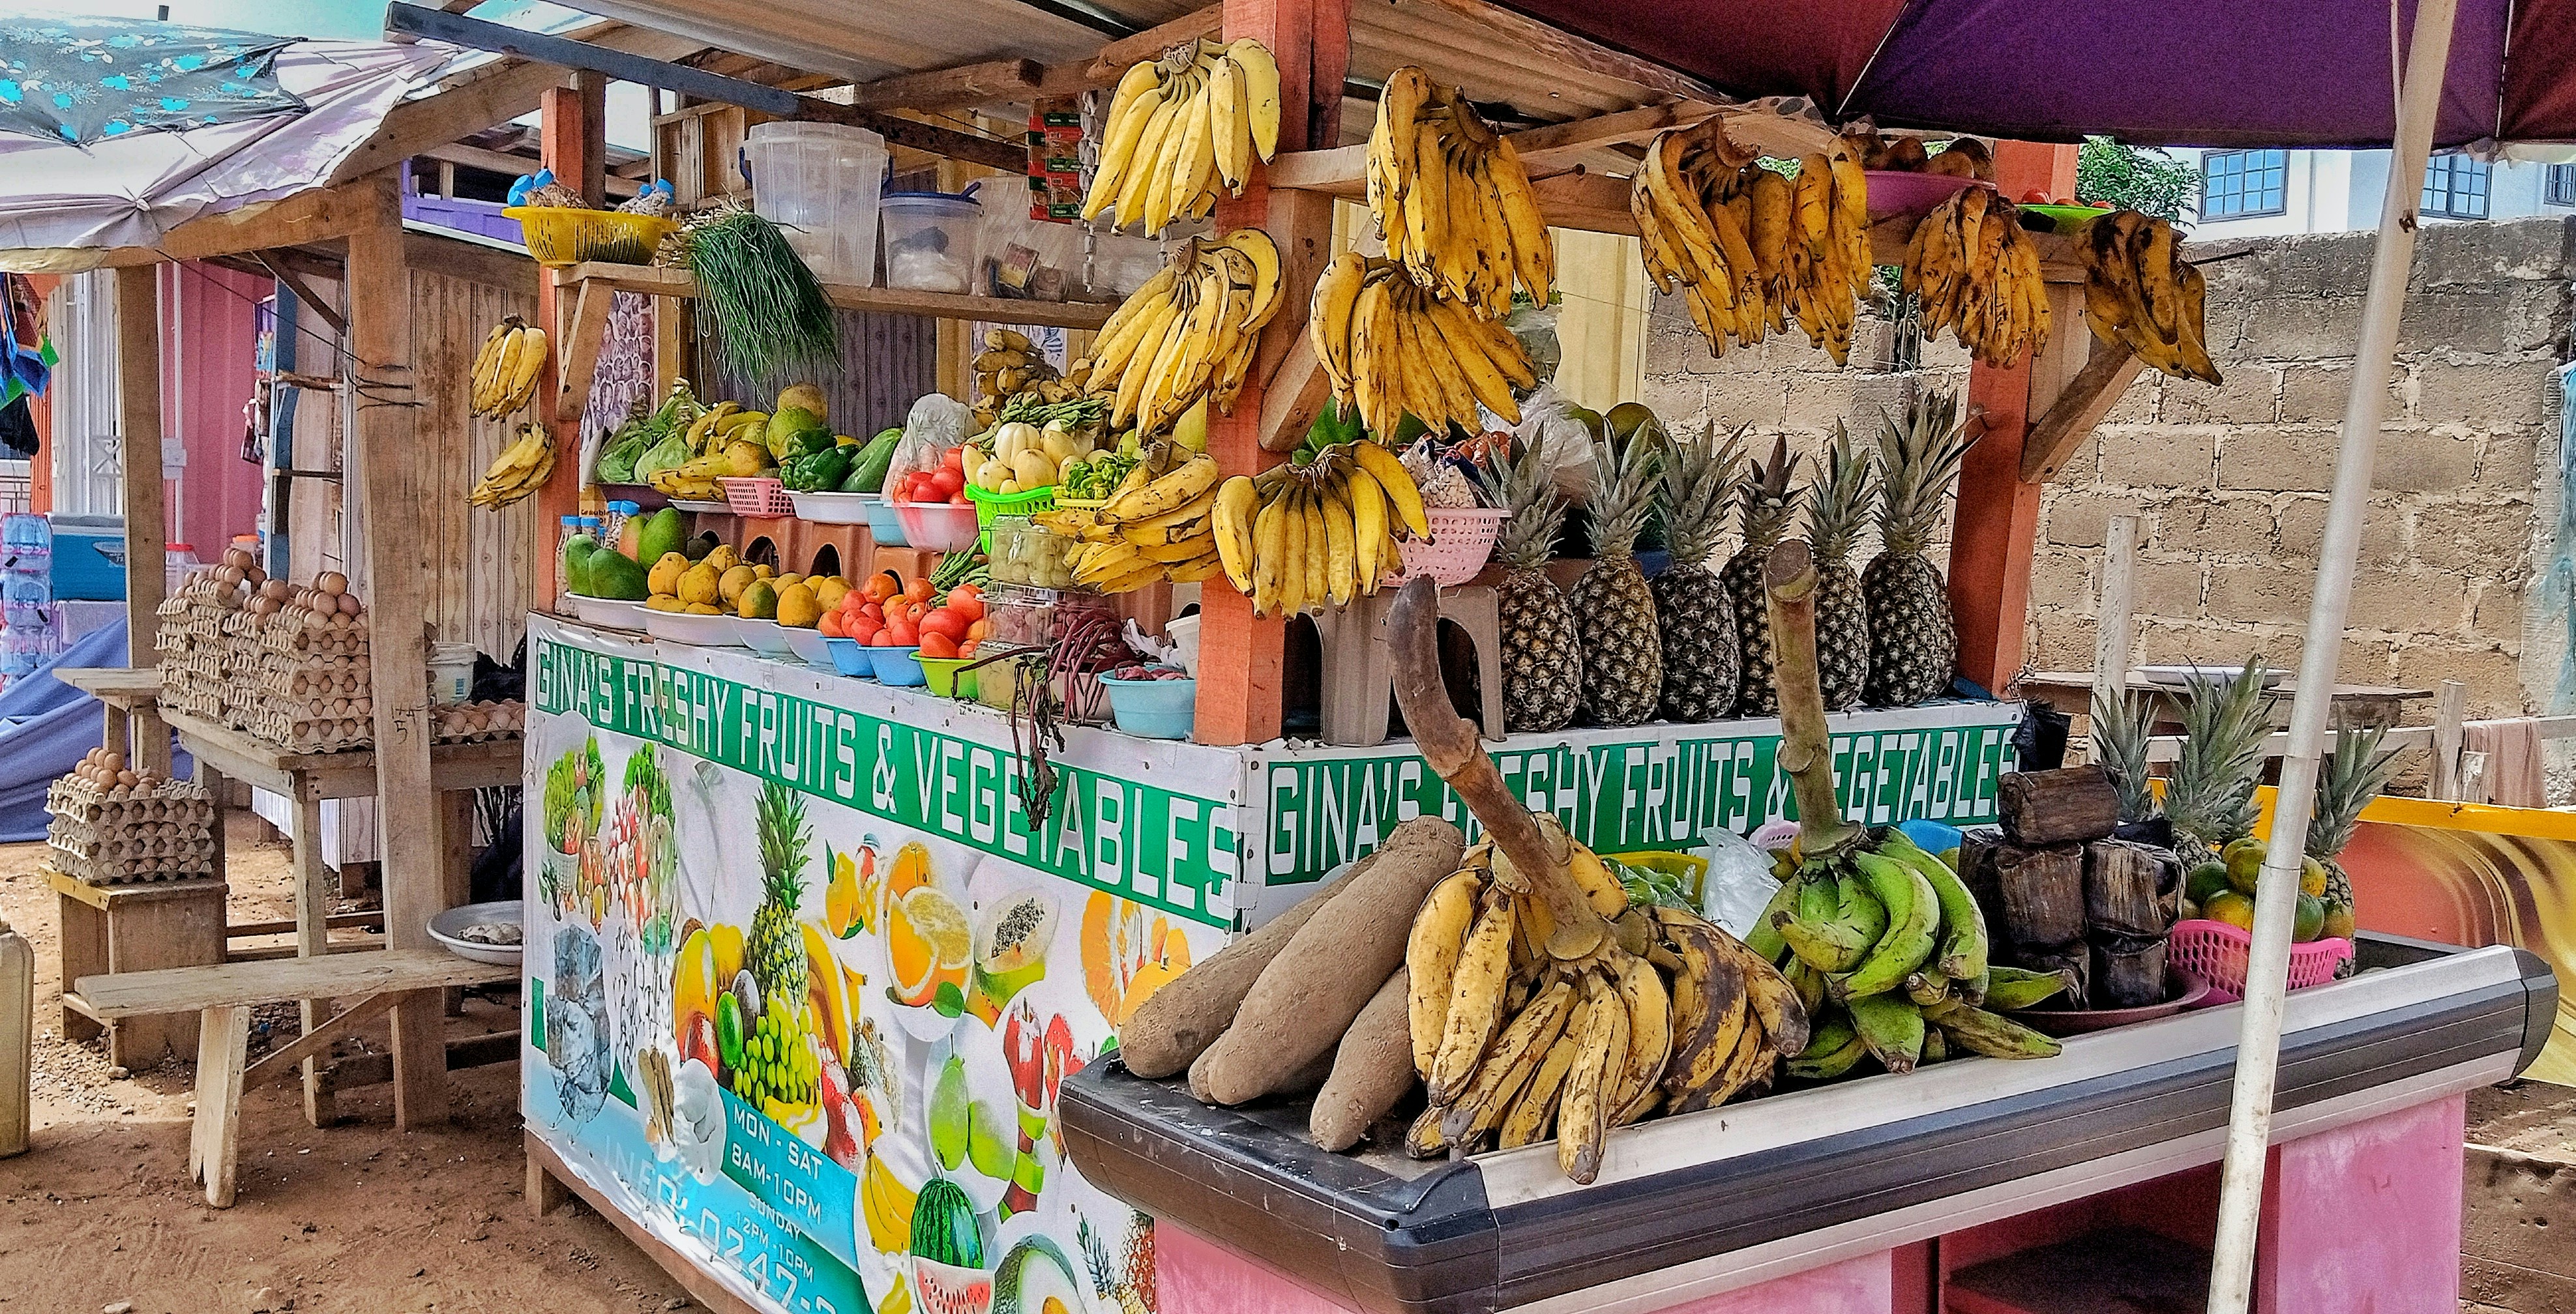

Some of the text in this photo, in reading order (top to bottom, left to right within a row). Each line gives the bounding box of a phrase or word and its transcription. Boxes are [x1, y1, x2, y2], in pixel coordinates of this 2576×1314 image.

[536, 639, 612, 724] GINA'S
[623, 662, 731, 758] FRESHY
[741, 688, 856, 800] FRUITS
[872, 722, 898, 814] &
[1269, 760, 1422, 875] GINA'S
[1442, 749, 1609, 850] SHY
[1619, 740, 1754, 845] FRUITS
[1829, 727, 2017, 825] EGETABLE
[733, 1103, 771, 1147] MON
[787, 1141, 823, 1180] SAT
[731, 1143, 822, 1225] 8AM-10PM
[748, 1191, 803, 1242] SUNDAY
[736, 1211, 769, 1249] 12PM
